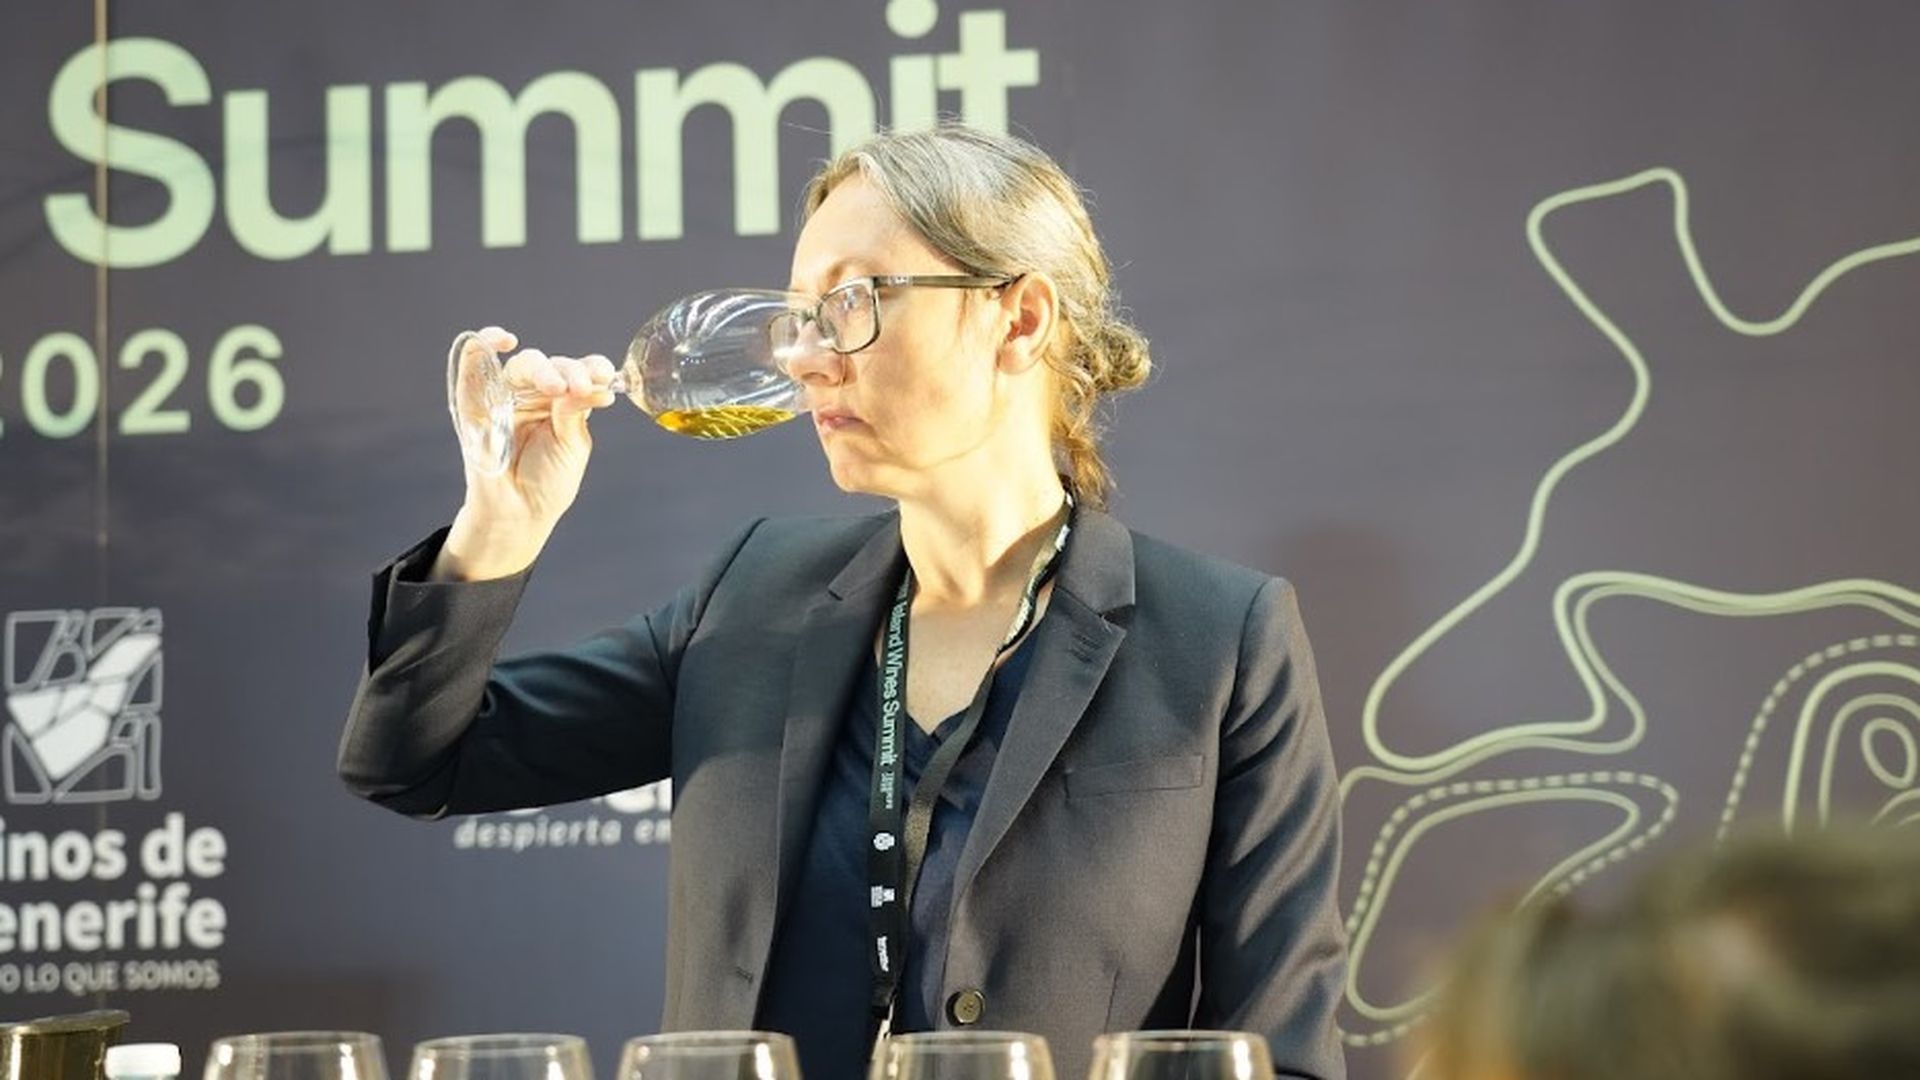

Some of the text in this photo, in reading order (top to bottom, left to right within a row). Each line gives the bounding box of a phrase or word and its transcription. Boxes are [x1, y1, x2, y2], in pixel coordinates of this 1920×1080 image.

[44, 0, 1040, 269] Summit
[0, 324, 285, 439] 026
[883, 647, 904, 699] Wines
[880, 700, 900, 767] Summit
[0, 811, 228, 882] nos de
[454, 814, 622, 854] despierta
[23, 963, 60, 993] LO
[63, 961, 119, 996] QUE
[123, 958, 221, 991] SOMOS
